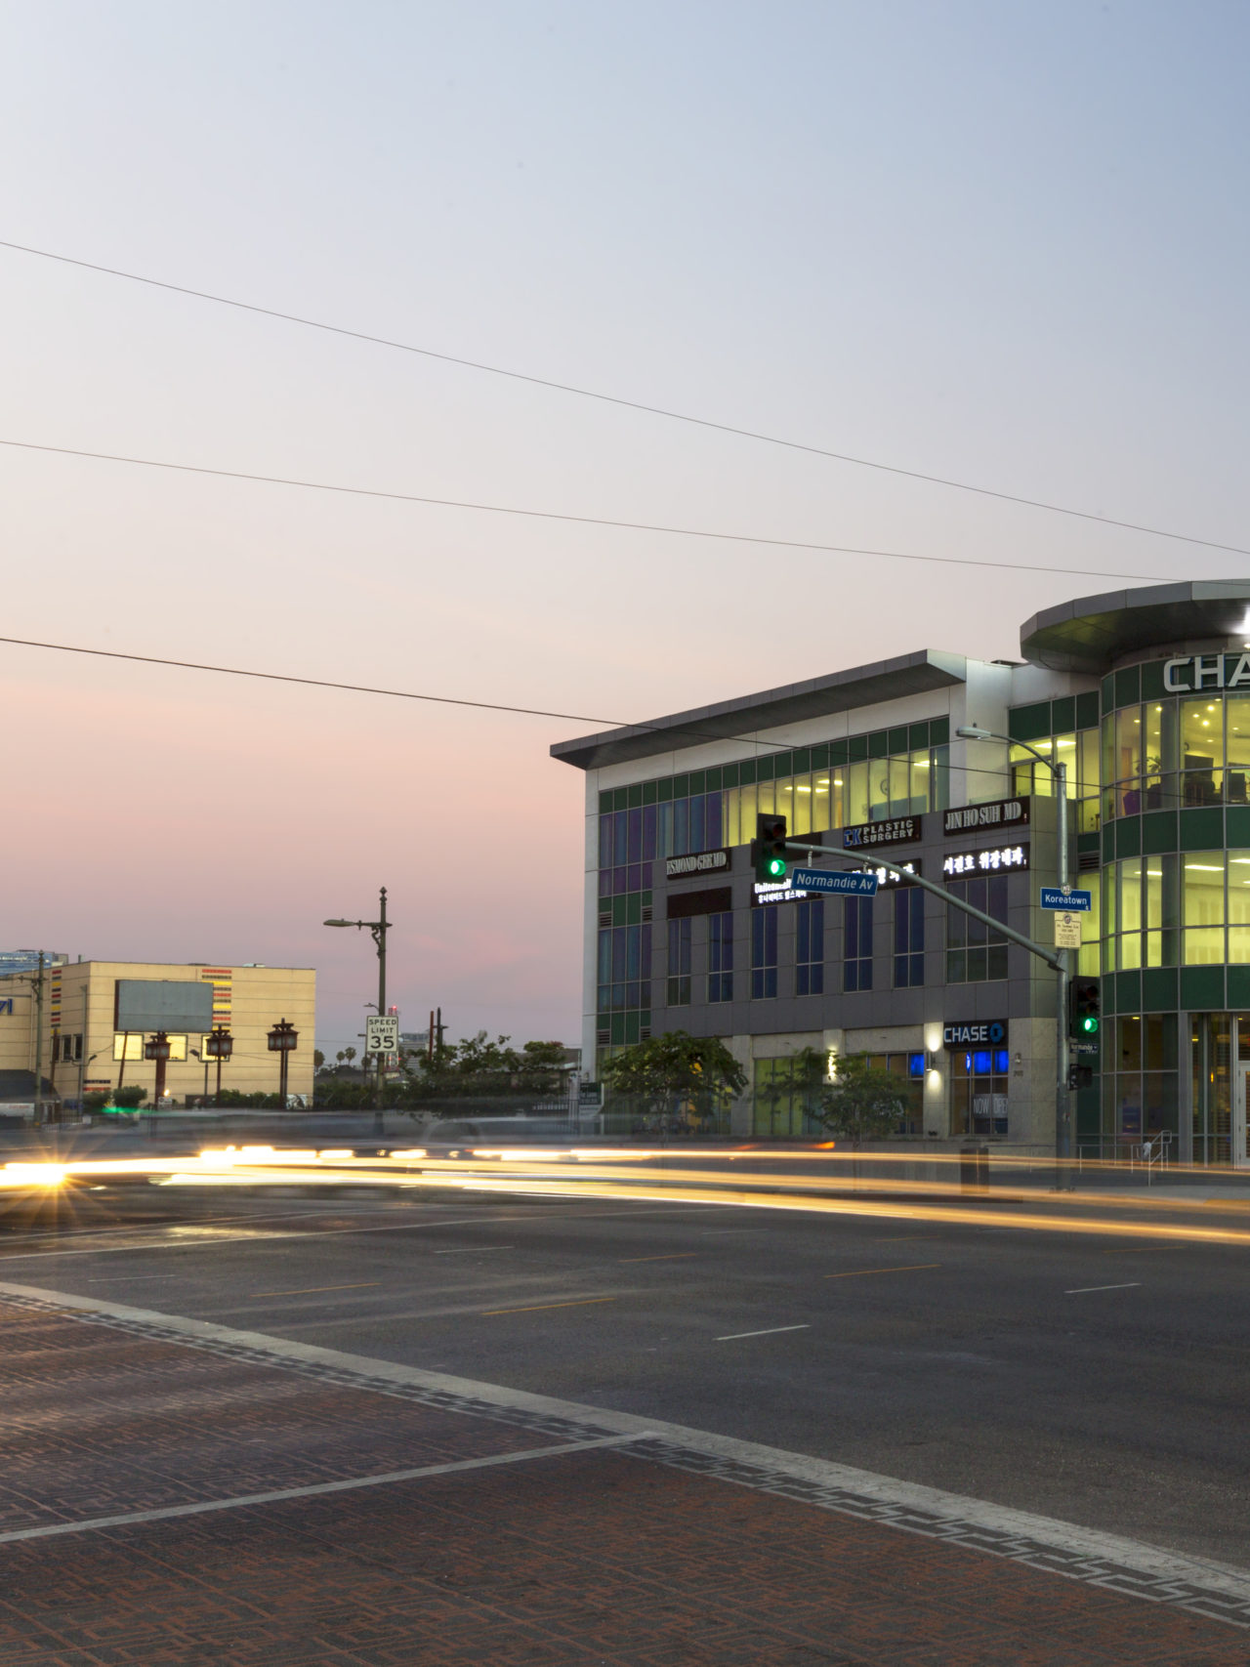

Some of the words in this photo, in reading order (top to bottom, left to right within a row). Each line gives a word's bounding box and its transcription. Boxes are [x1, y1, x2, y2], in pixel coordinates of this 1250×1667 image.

[945, 811, 962, 830] JIN
[963, 809, 979, 827] HO
[979, 804, 1001, 824] SUH
[1003, 802, 1021, 820] MD
[863, 820, 914, 835] PLASTIC
[863, 828, 914, 844] SURGERY
[796, 873, 857, 889] Normandie
[858, 878, 874, 890] Av
[1045, 894, 1087, 905] Koreatown
[370, 1035, 395, 1049] 35
[944, 1025, 988, 1043] CHASE
[973, 1097, 989, 1115] NOW
